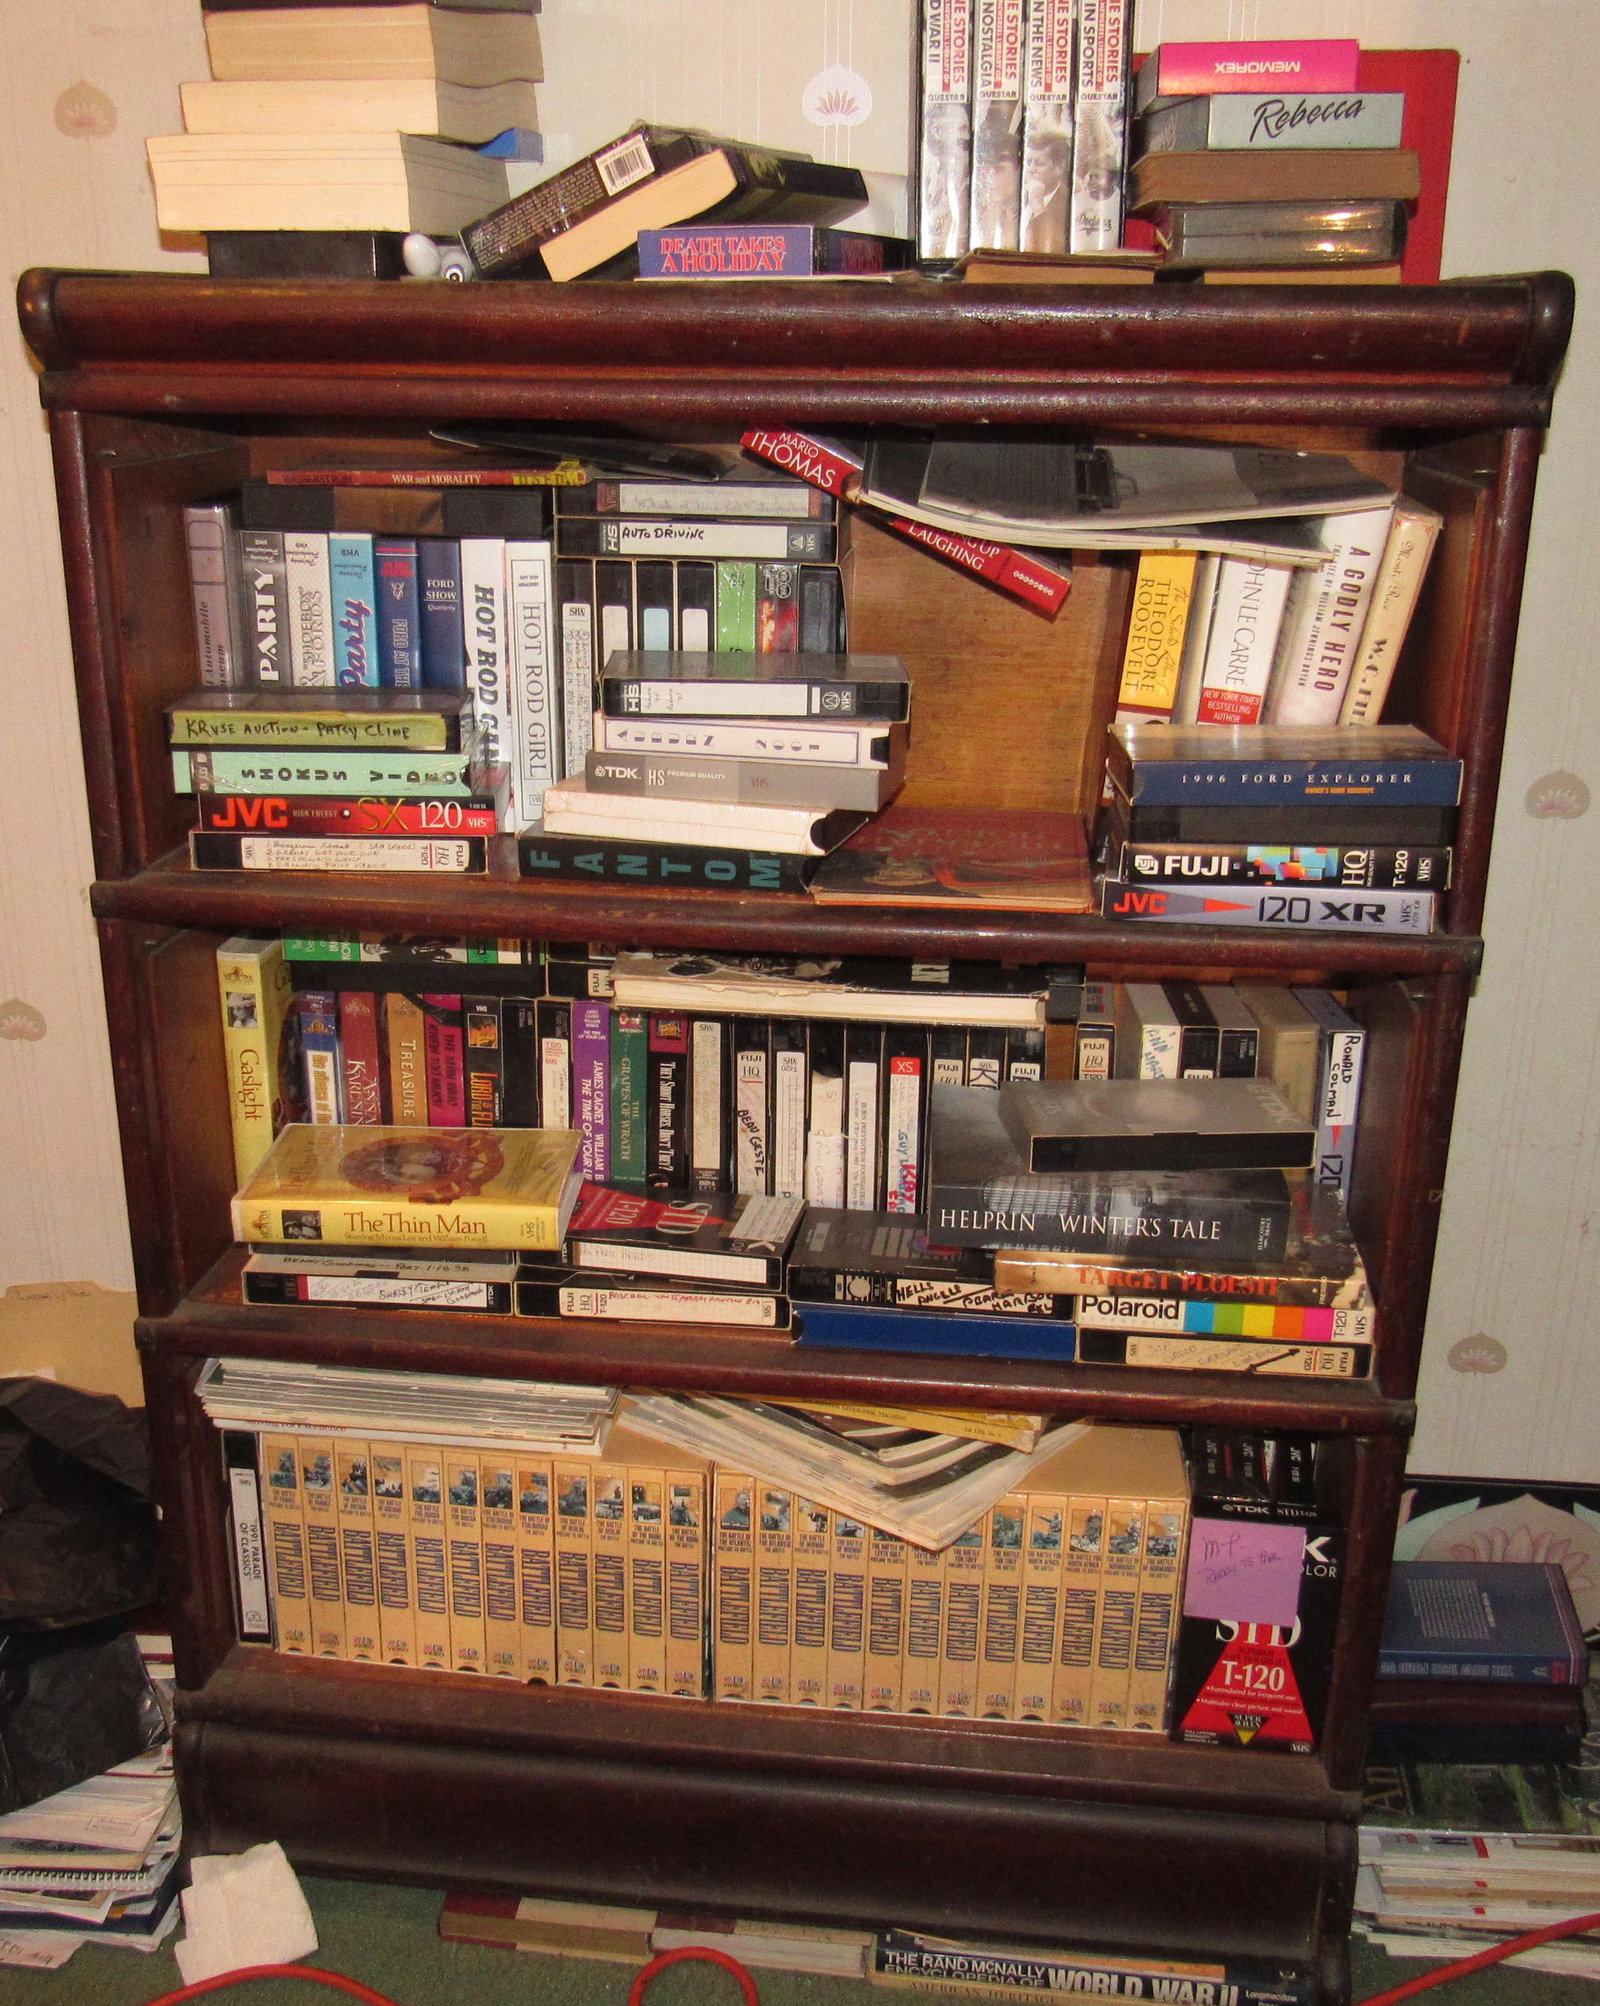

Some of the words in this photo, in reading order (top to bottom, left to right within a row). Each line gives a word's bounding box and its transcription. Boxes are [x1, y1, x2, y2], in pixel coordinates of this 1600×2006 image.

[1084, 2, 1096, 22] IN
[929, 11, 941, 49] WAR
[1032, 17, 1044, 44] THE
[953, 18, 966, 84] STORIES
[980, 2, 994, 88] NOSTALGIA
[1005, 14, 1018, 80] STORIES
[1055, 18, 1069, 84] STORIES
[1082, 26, 1096, 88] SPORTS
[1106, 17, 1120, 84] STORIES
[1030, 51, 1043, 88] NEWS
[1214, 60, 1301, 74] MEMOREX
[979, 90, 1017, 99] QUESTAR
[1081, 93, 1118, 101] QUESTAR
[1249, 98, 1366, 143] Rebecca
[660, 238, 724, 255] DEATH
[725, 236, 786, 254] TAKES
[661, 255, 680, 273] A
[682, 254, 787, 272] HOLIDAY
[779, 433, 819, 458] MARLO
[753, 432, 836, 488] THOMAS
[391, 474, 412, 485] WAR
[414, 475, 431, 485] and
[431, 474, 481, 485] MORALITY
[341, 549, 359, 557] VHS
[908, 523, 985, 571] LAUGHING
[1349, 546, 1371, 557] A
[425, 589, 457, 600] SHOW
[427, 579, 455, 590] FORD
[475, 584, 496, 642] HOT
[1318, 591, 1330, 622] WILLIAM
[1330, 569, 1366, 632] GODLY
[253, 567, 280, 682] PARTY
[310, 590, 326, 666] FORDS
[1237, 605, 1258, 625] LE
[392, 619, 409, 649] FORD
[522, 604, 542, 656] HOT
[1125, 578, 1155, 691] ROOSEVELT
[1140, 579, 1172, 692] THEODORE
[1306, 625, 1321, 661] JENNINGS
[1224, 628, 1256, 687] CARRÉ
[1314, 641, 1346, 692] HERO
[476, 651, 499, 705] ROD
[1298, 663, 1310, 686] BRYAN
[525, 665, 544, 714] ROD
[1203, 690, 1220, 699] NEW
[1221, 692, 1238, 701] YORK
[1239, 695, 1260, 705] TIMES
[1207, 701, 1251, 715] BESTSELLING
[1213, 713, 1240, 723] AUTHOR
[528, 723, 547, 778] GIRL
[755, 739, 820, 751] 2001
[241, 767, 348, 783] SHOKUS
[369, 769, 457, 784] VIDEO
[605, 766, 638, 780] TDK
[648, 769, 666, 787] HS
[667, 770, 696, 778] PREMIUM
[697, 772, 726, 780] QUALITY
[1182, 775, 1226, 783] 1996
[1241, 775, 1293, 783] FORD
[1307, 775, 1413, 783] EXPLORER
[212, 798, 289, 828] JVC
[357, 797, 410, 831] SX
[418, 801, 463, 830] 120
[468, 818, 487, 827] VHS
[437, 846, 450, 865] HQ
[456, 844, 465, 867] FUJI
[1164, 856, 1229, 876] FUJI
[1342, 850, 1366, 886] HQ
[1392, 850, 1408, 887] T-120
[529, 850, 782, 888] FANTOM
[1417, 858, 1431, 881] VHS
[1113, 893, 1167, 914] JVC
[1258, 897, 1310, 923] 120
[1320, 902, 1386, 923] XR
[592, 972, 600, 993] FUJI
[1083, 1042, 1105, 1050] FUJI
[1342, 1035, 1361, 1083] RONALD
[742, 1066, 760, 1080] HQ
[897, 1061, 914, 1073] XS
[1014, 1067, 1036, 1075] FUJI
[1085, 1055, 1103, 1068] HQ
[237, 1049, 264, 1121] Gaslight
[400, 1040, 417, 1119] TREASURE
[471, 1072, 498, 1100] LORD
[582, 1079, 592, 1096] THE
[593, 1061, 604, 1089] JAMES
[621, 1058, 631, 1100] GRAPES
[1326, 1063, 1341, 1118] COLMAN
[582, 1099, 592, 1121] TIME
[593, 1091, 604, 1125] CAGNEY
[621, 1102, 630, 1118] OF
[582, 1123, 592, 1138] OF
[621, 1120, 631, 1160] WRATH
[582, 1139, 592, 1167] YOUR
[594, 1134, 604, 1170] WILLIAM
[750, 1134, 764, 1176] GESTE
[344, 1211, 382, 1233] The
[383, 1212, 434, 1234] Thin
[436, 1214, 487, 1235] Man
[605, 1199, 647, 1225] T-120
[656, 1200, 713, 1235] STD
[939, 1209, 1036, 1232] HELPRIN
[1060, 1214, 1161, 1237] WINTER'S
[1170, 1219, 1222, 1241] TALE
[418, 1234, 432, 1242] and
[433, 1234, 463, 1243] William
[1076, 1267, 1170, 1291] TARGET
[1180, 1273, 1279, 1296] PLOESTI
[567, 1293, 575, 1312] FUJI
[579, 1295, 592, 1311] HQ
[1081, 1296, 1180, 1320] Polaroid
[1333, 1310, 1348, 1338] T-120
[1355, 1316, 1367, 1337] VHS
[1303, 1349, 1312, 1370] T-120
[1321, 1352, 1334, 1370] HQ
[1340, 1352, 1349, 1373] FUJI
[1232, 1505, 1270, 1514] TDK
[239, 1522, 246, 1534] OF
[252, 1540, 262, 1580] PARADE
[1222, 1660, 1285, 1692] T-120
[885, 1951, 918, 1966] THE
[921, 1955, 970, 1972] RAND
[1047, 1967, 1144, 1999] WORLD
[1152, 1978, 1216, 2006] WAR
[1217, 1984, 1238, 2006] II
